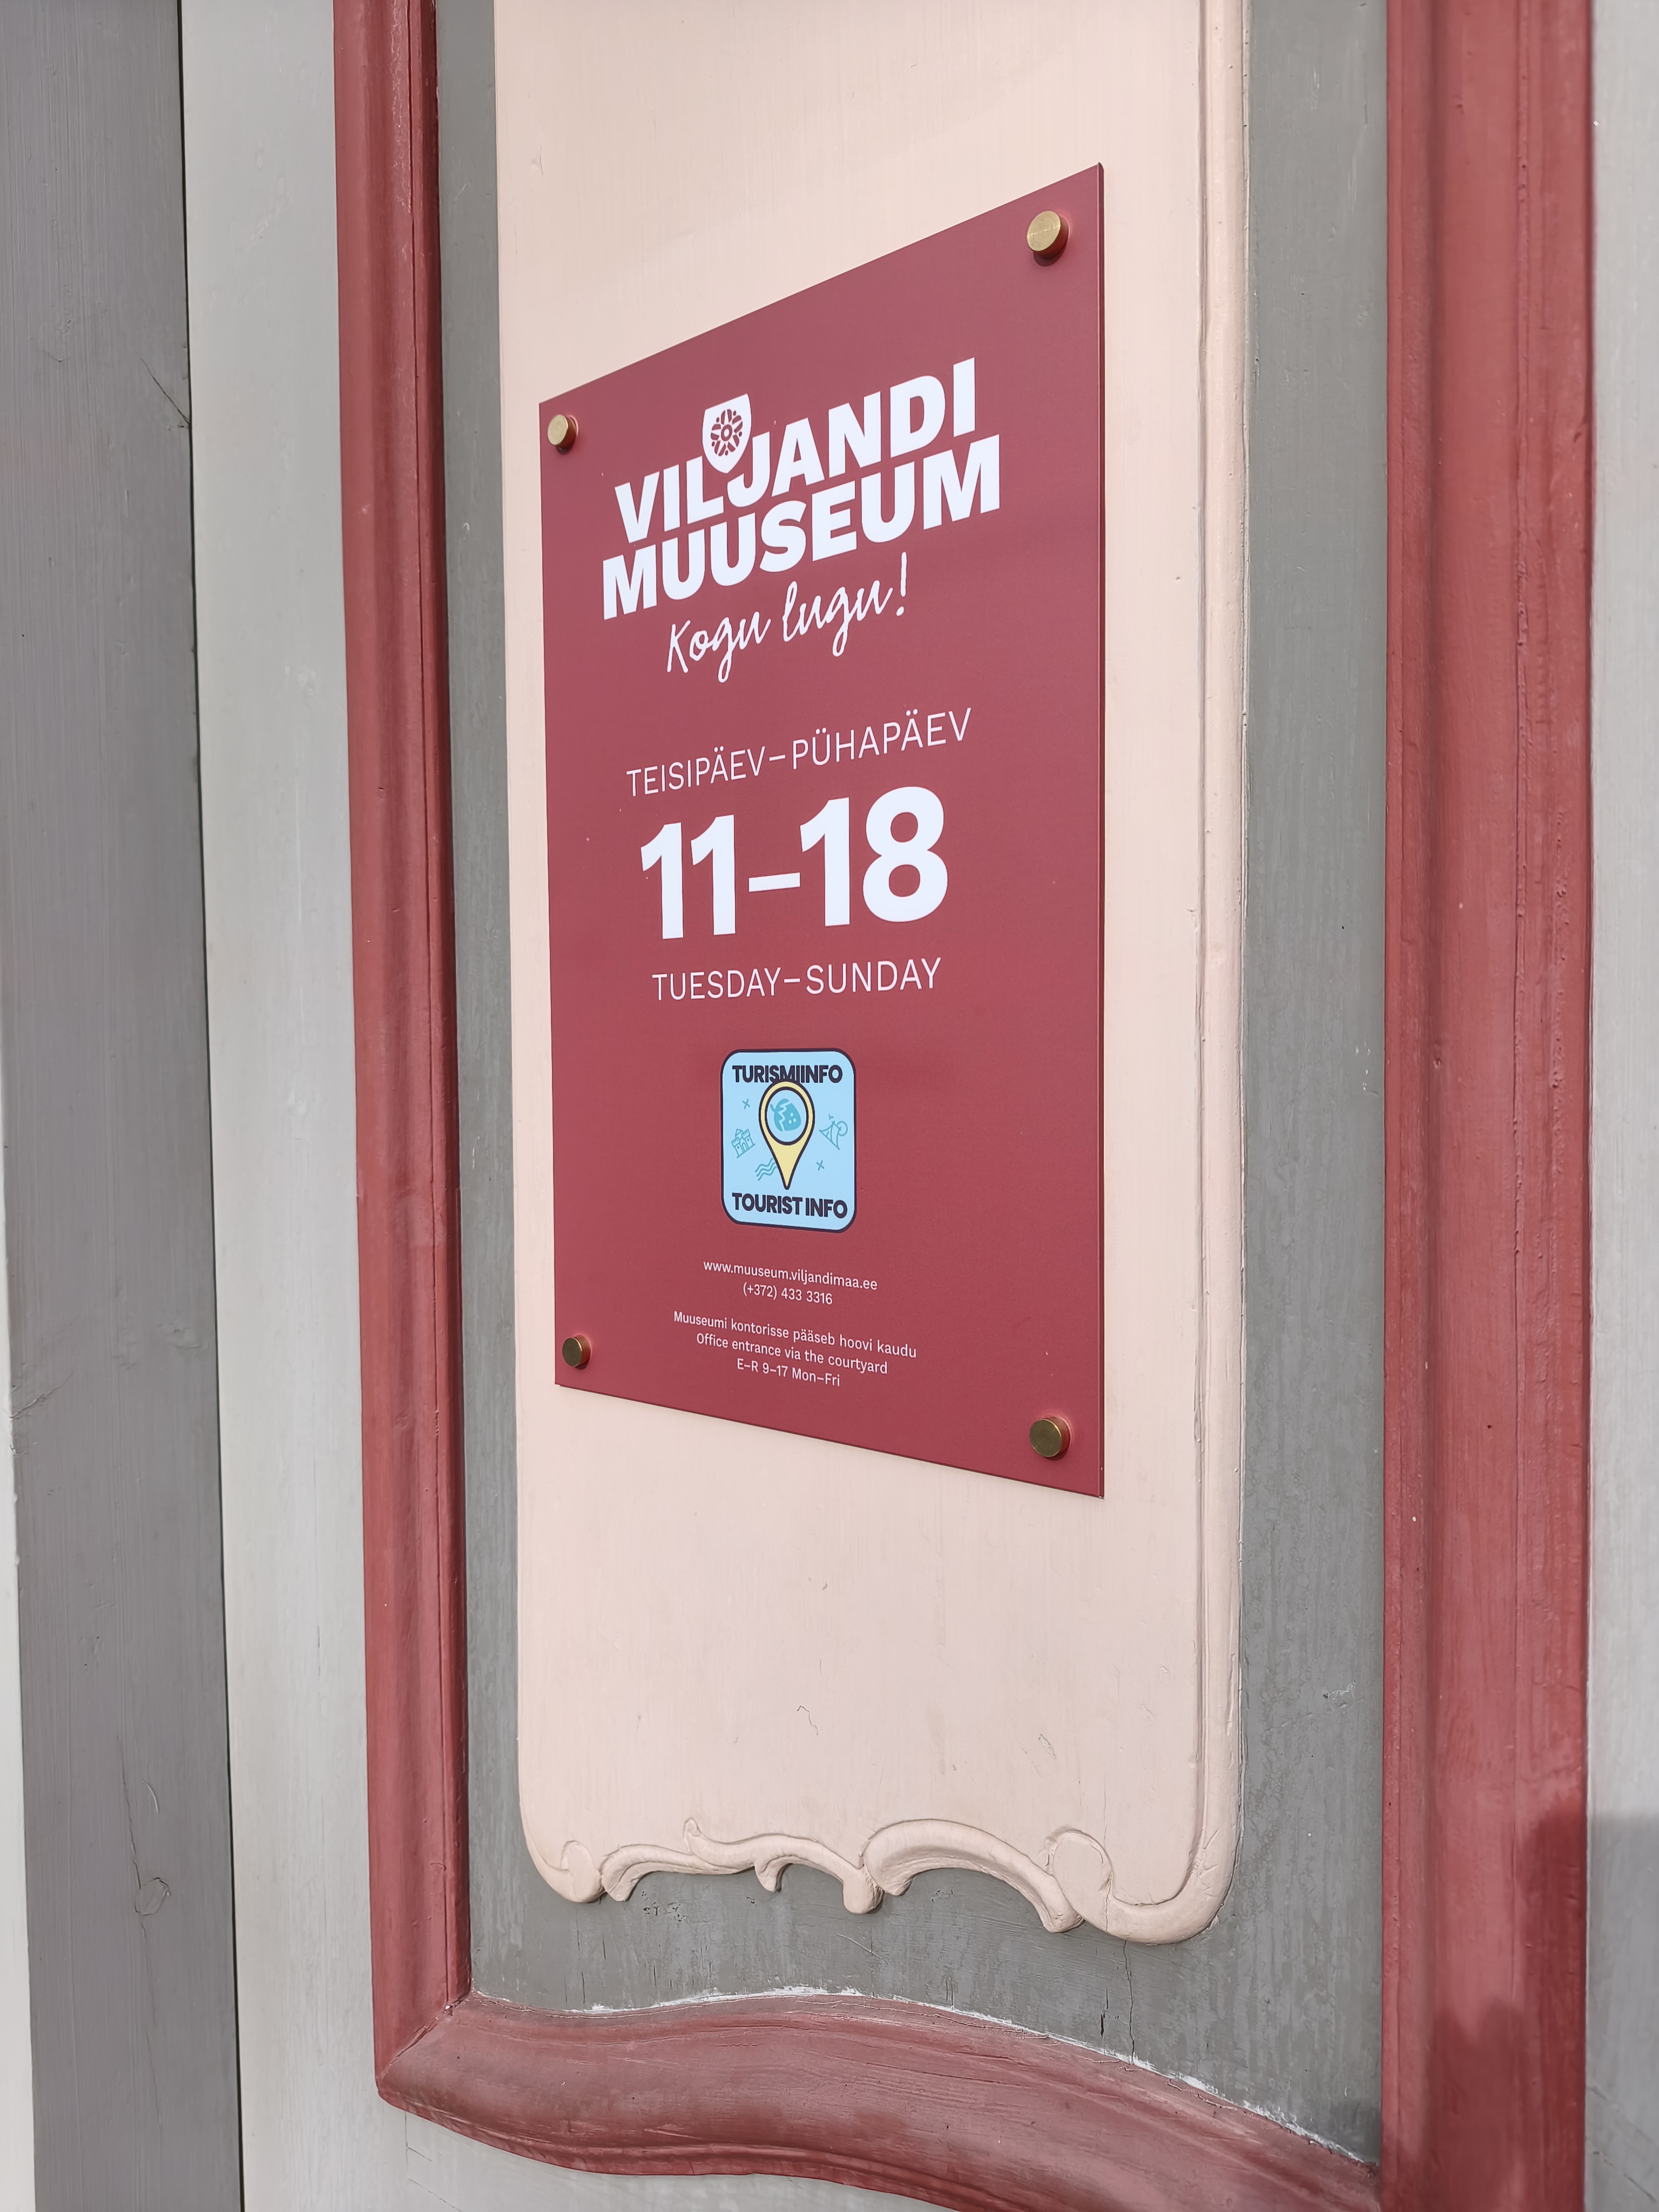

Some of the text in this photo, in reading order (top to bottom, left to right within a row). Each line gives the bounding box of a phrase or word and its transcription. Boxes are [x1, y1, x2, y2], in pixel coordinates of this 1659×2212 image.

[614, 357, 976, 544] VILJANDI
[602, 434, 1000, 620] MUUSEUM
[667, 551, 908, 683] Kogu lugu!
[732, 1064, 843, 1083] TURISMIINFO
[732, 1192, 848, 1219] TOURIST INFO
[703, 1260, 878, 1290] www.muuseum.viljandimaa.ee
[743, 1282, 833, 1305] (+372) 433 3316
[673, 1311, 917, 1358] Muuseumi kontorisse pääseb hoovi kaudu
[696, 1332, 888, 1374] Office entrance via the courtyard
